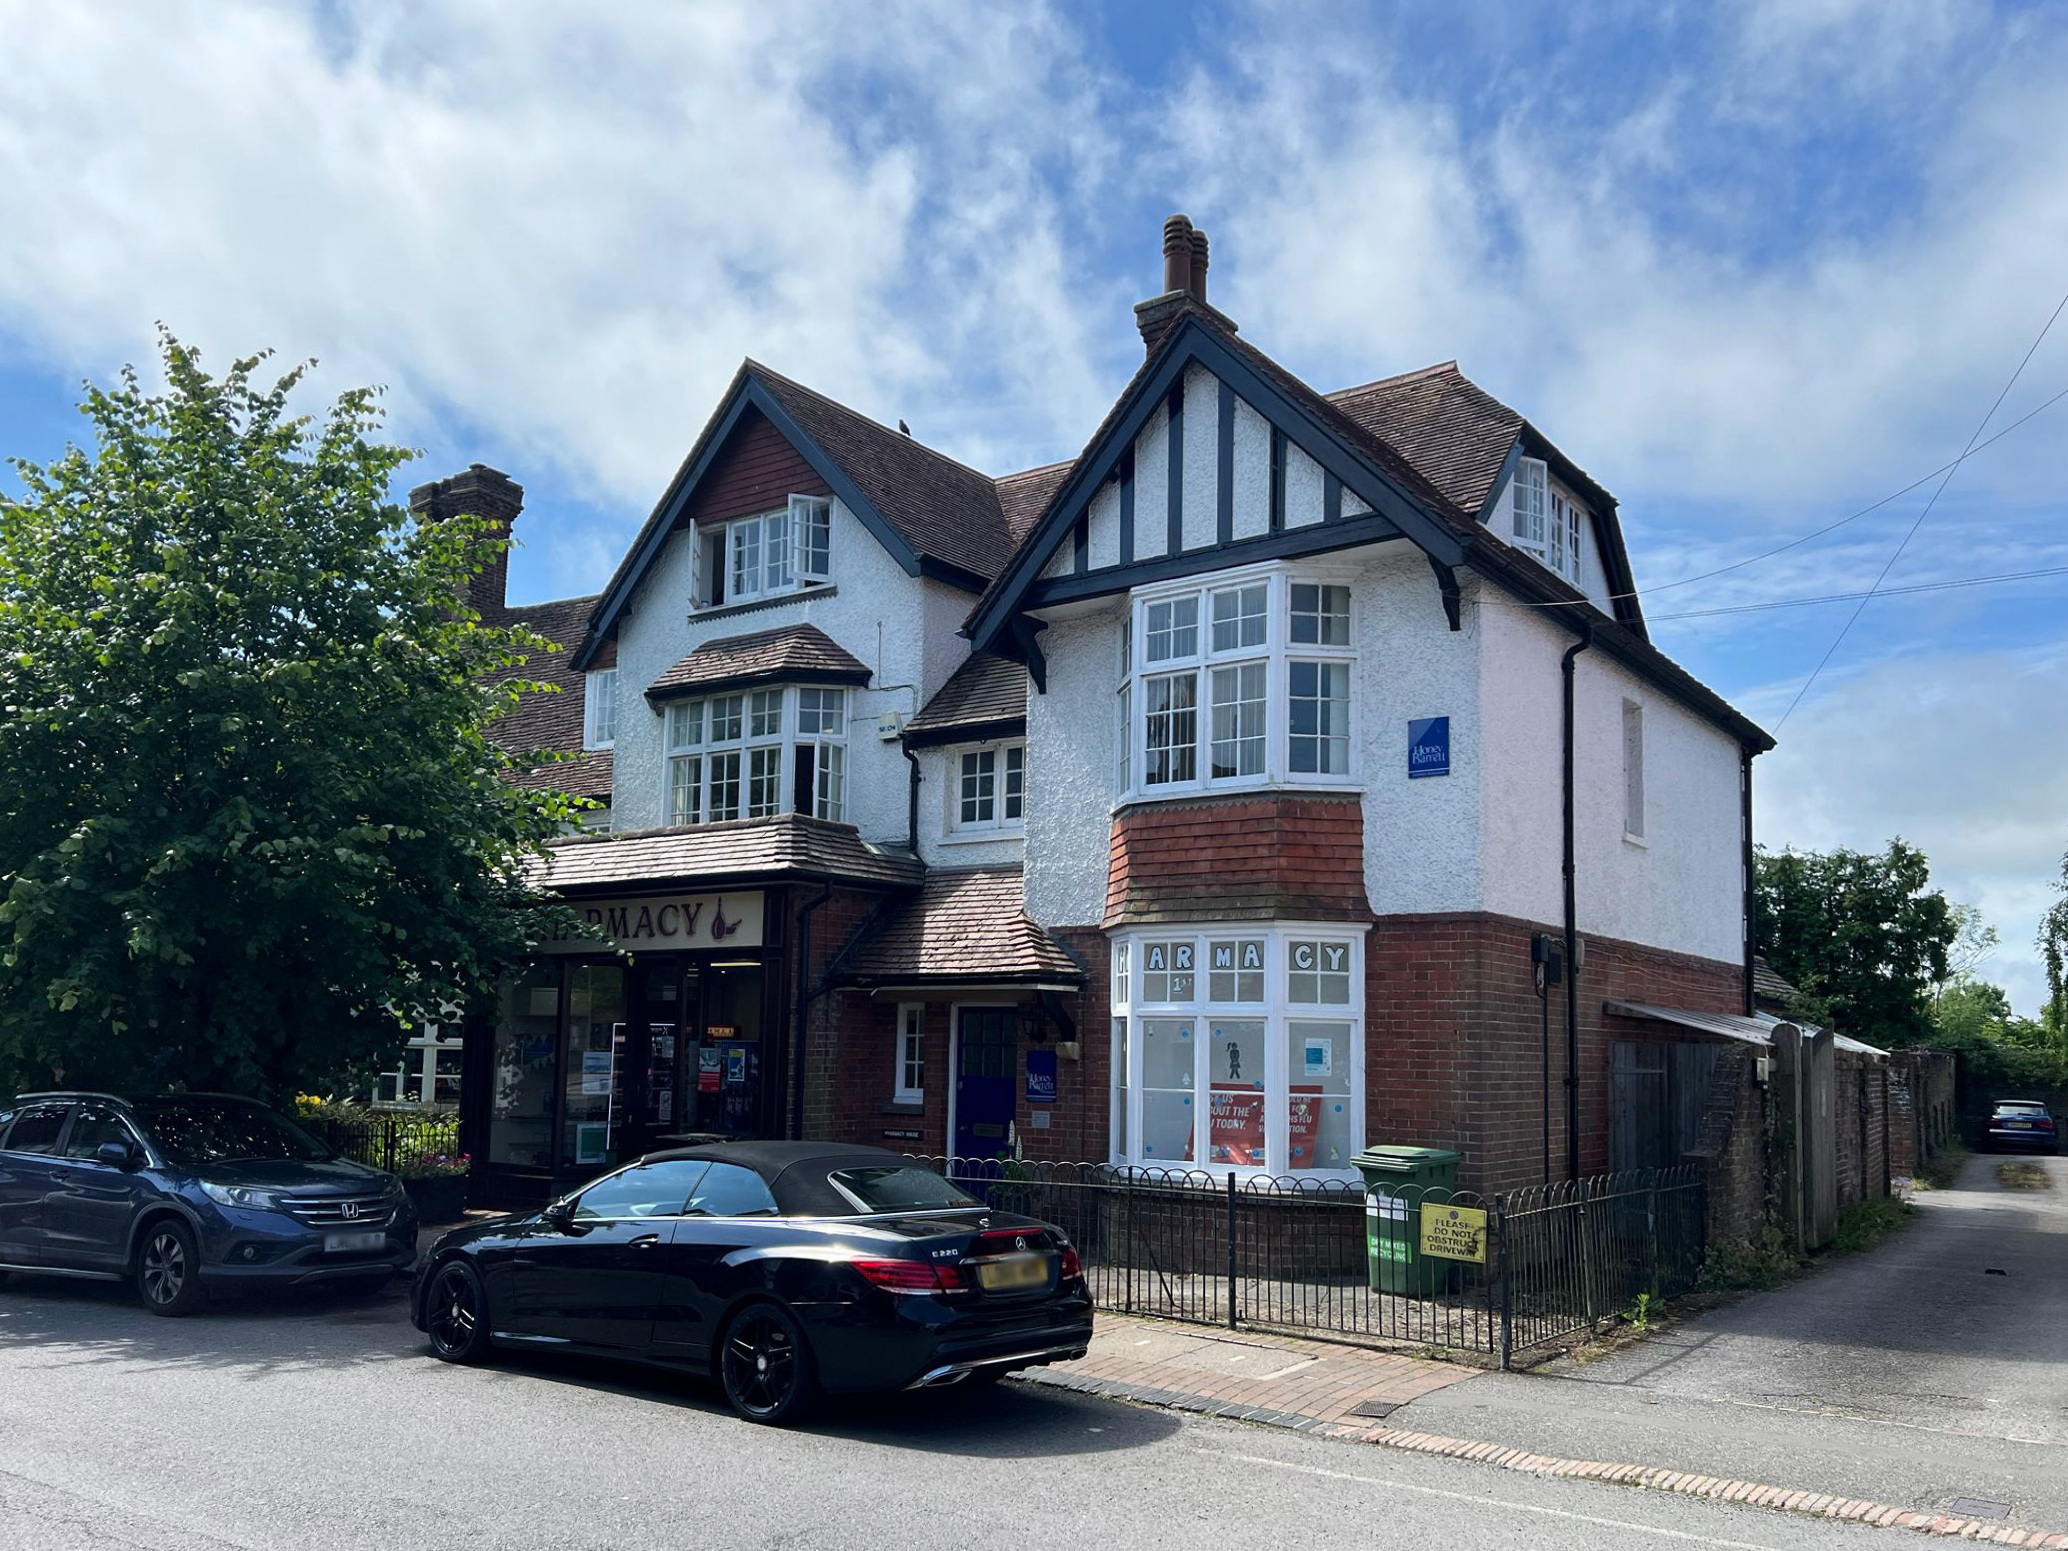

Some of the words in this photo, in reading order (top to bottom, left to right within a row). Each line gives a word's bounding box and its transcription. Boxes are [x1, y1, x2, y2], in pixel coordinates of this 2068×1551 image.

[1413, 745, 1443, 756] Honey
[1233, 1106, 1250, 1117] THE
[1434, 1227, 1448, 1237] DO
[1451, 1229, 1471, 1239] NOT
[1427, 1235, 1478, 1249] OBSTRUCT
